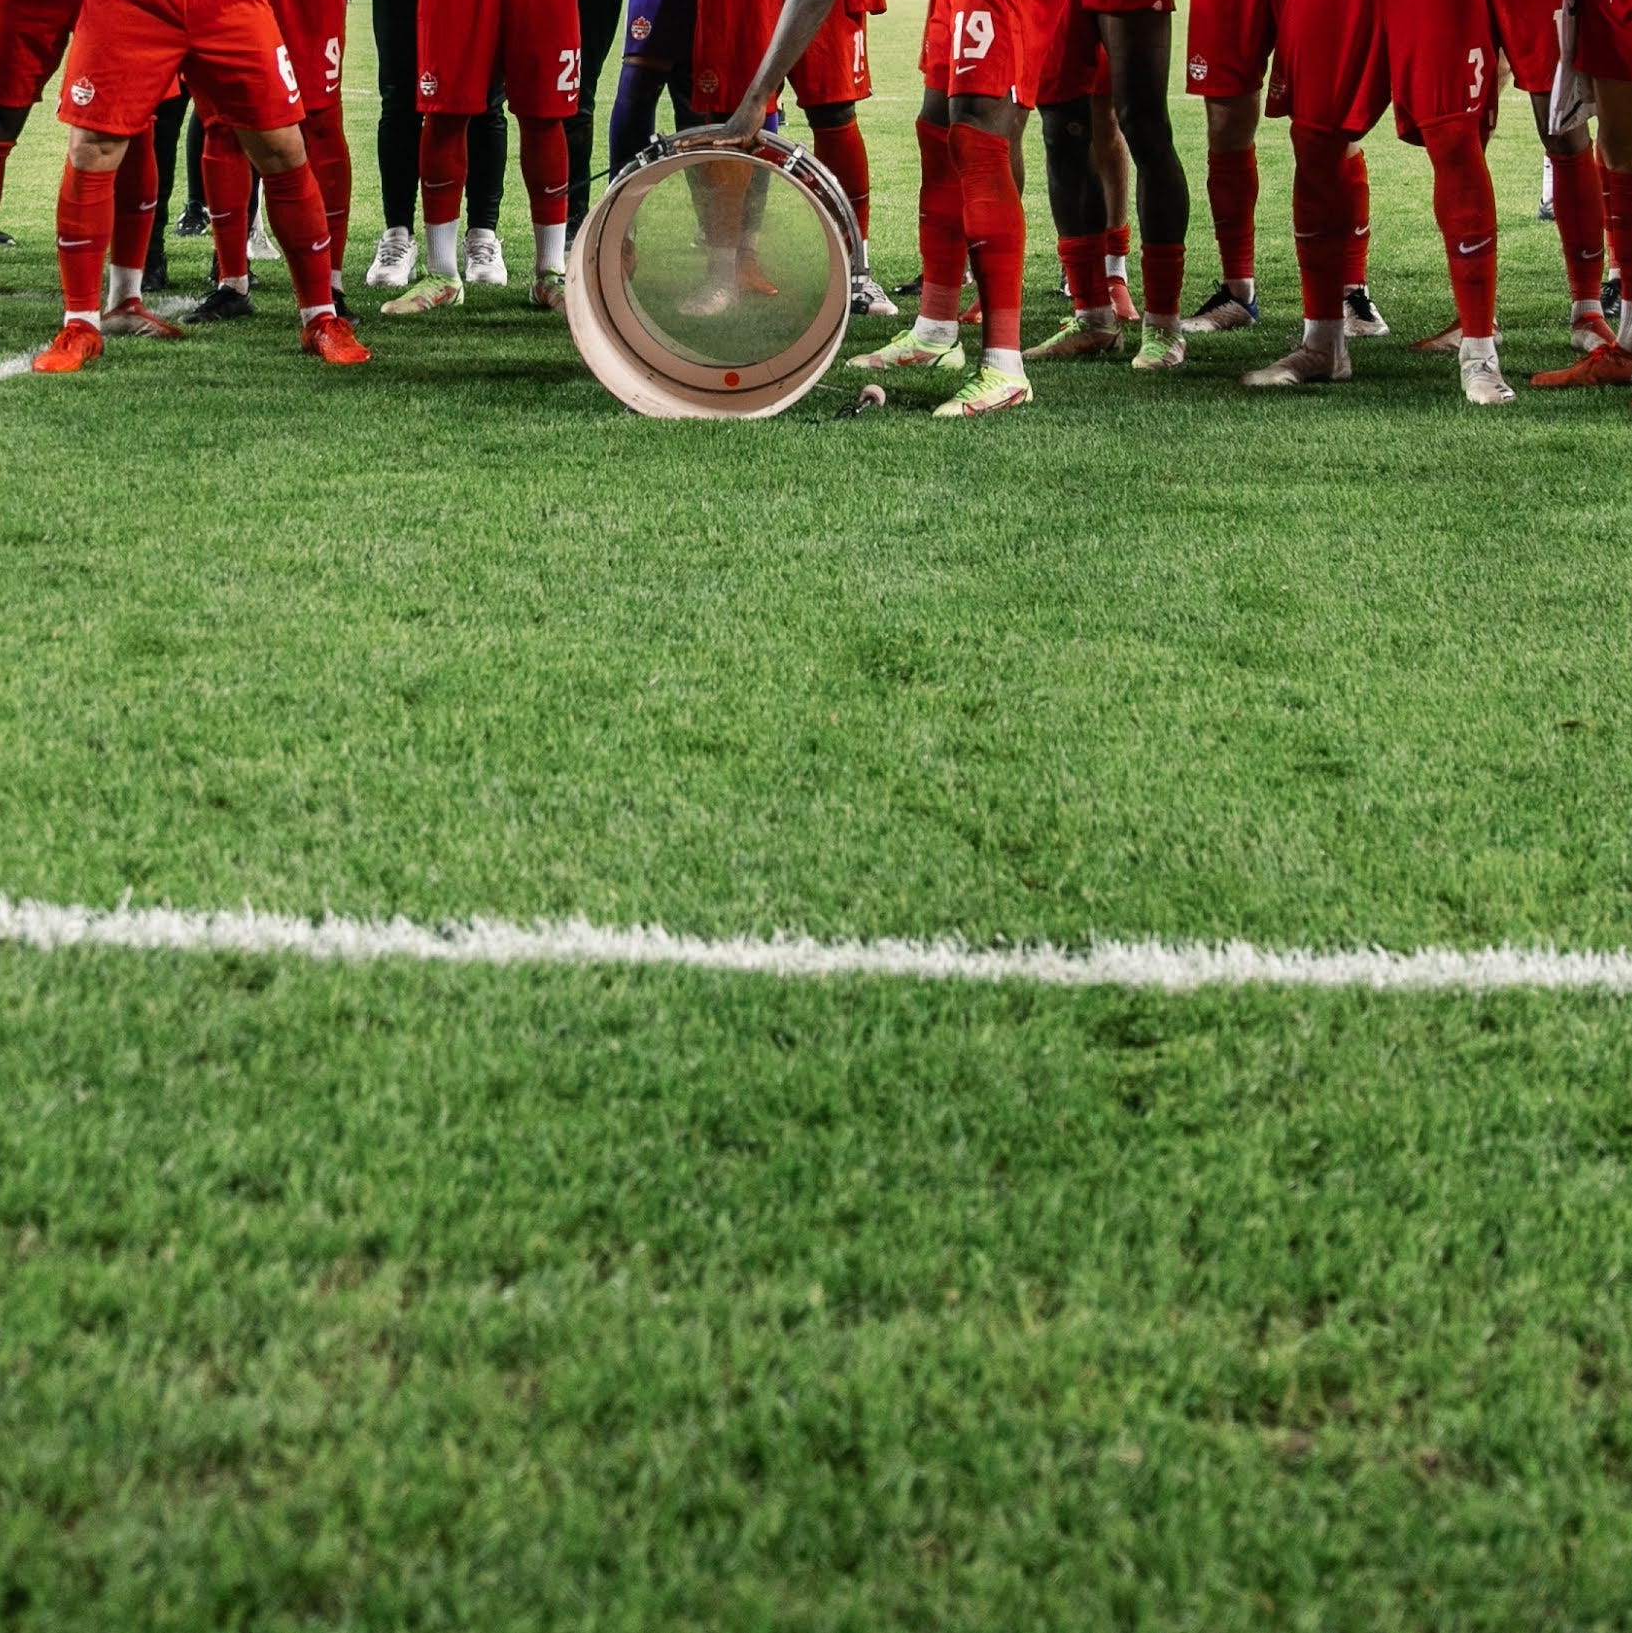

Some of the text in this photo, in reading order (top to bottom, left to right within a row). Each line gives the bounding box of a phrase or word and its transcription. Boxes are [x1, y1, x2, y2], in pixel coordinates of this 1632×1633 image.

[324, 37, 342, 80] 9
[953, 10, 995, 60] 19
[276, 44, 299, 92] 6
[1468, 47, 1484, 98] 3
